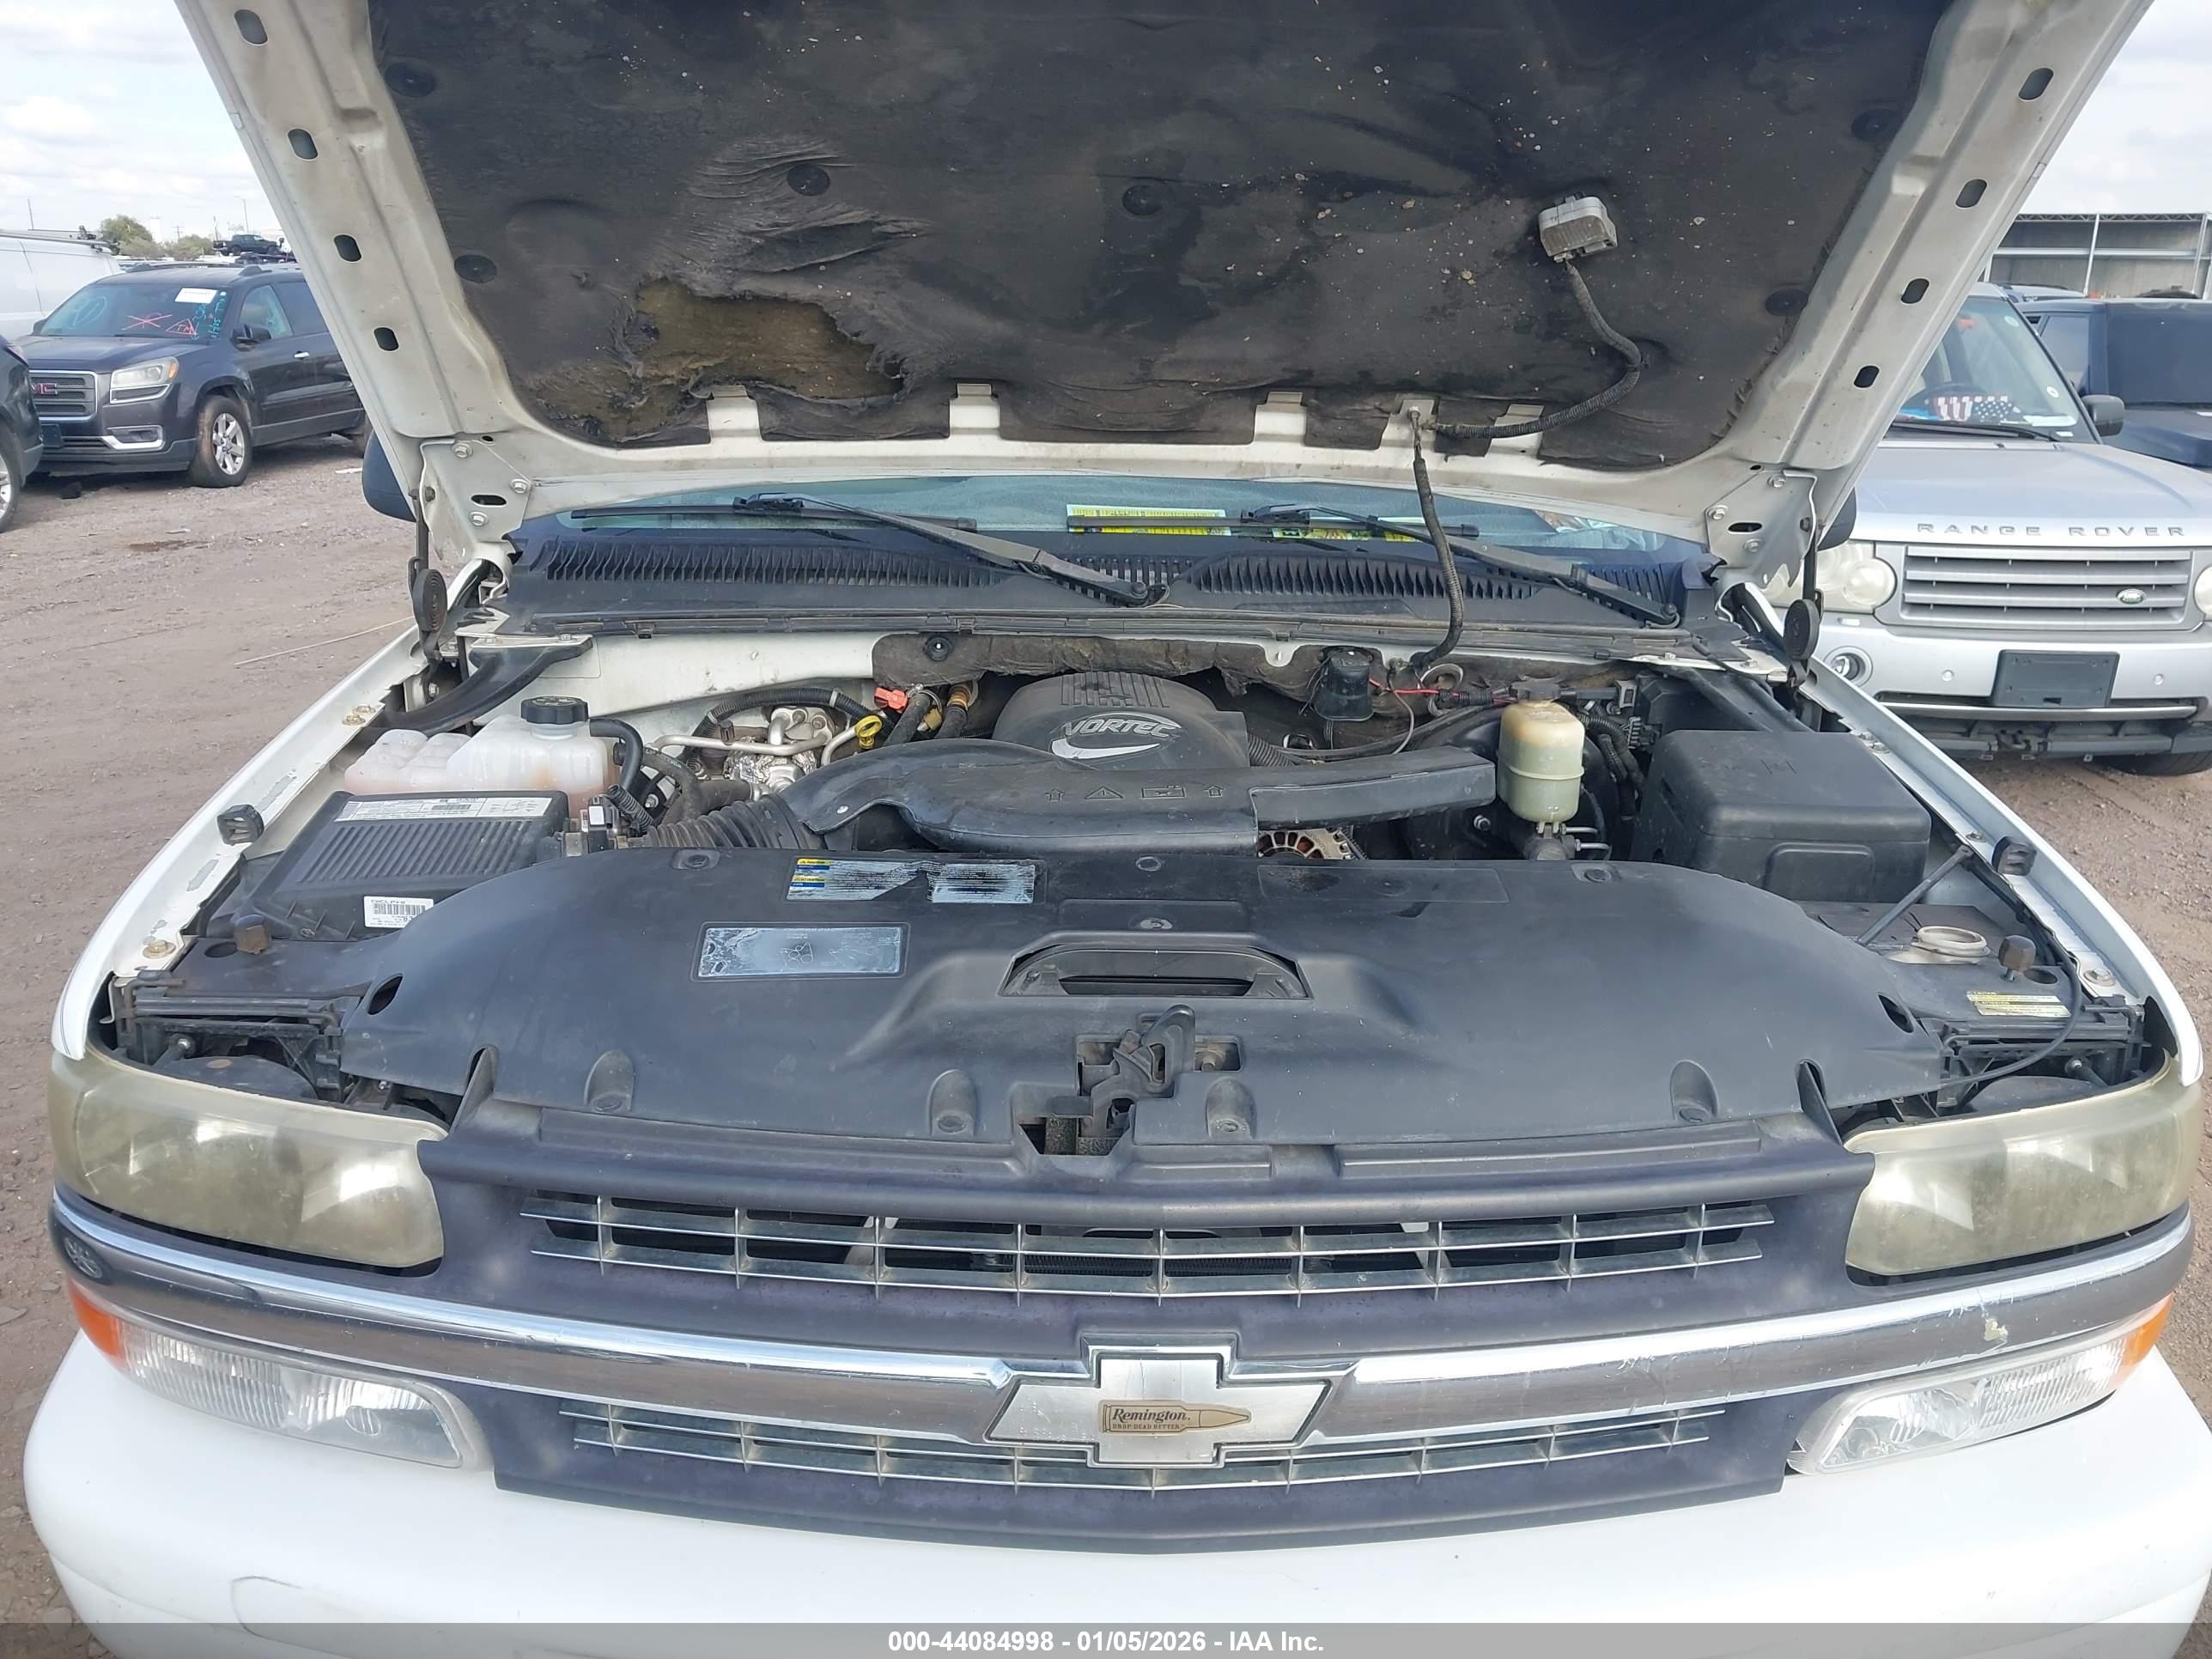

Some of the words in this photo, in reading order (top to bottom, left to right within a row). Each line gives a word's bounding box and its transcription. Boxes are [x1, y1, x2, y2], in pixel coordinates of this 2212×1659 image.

[30, 383, 58, 395] MC
[1917, 522, 2042, 536] RANGE
[2068, 526, 2185, 537] ROVER
[1050, 718, 1177, 738] VORTEC
